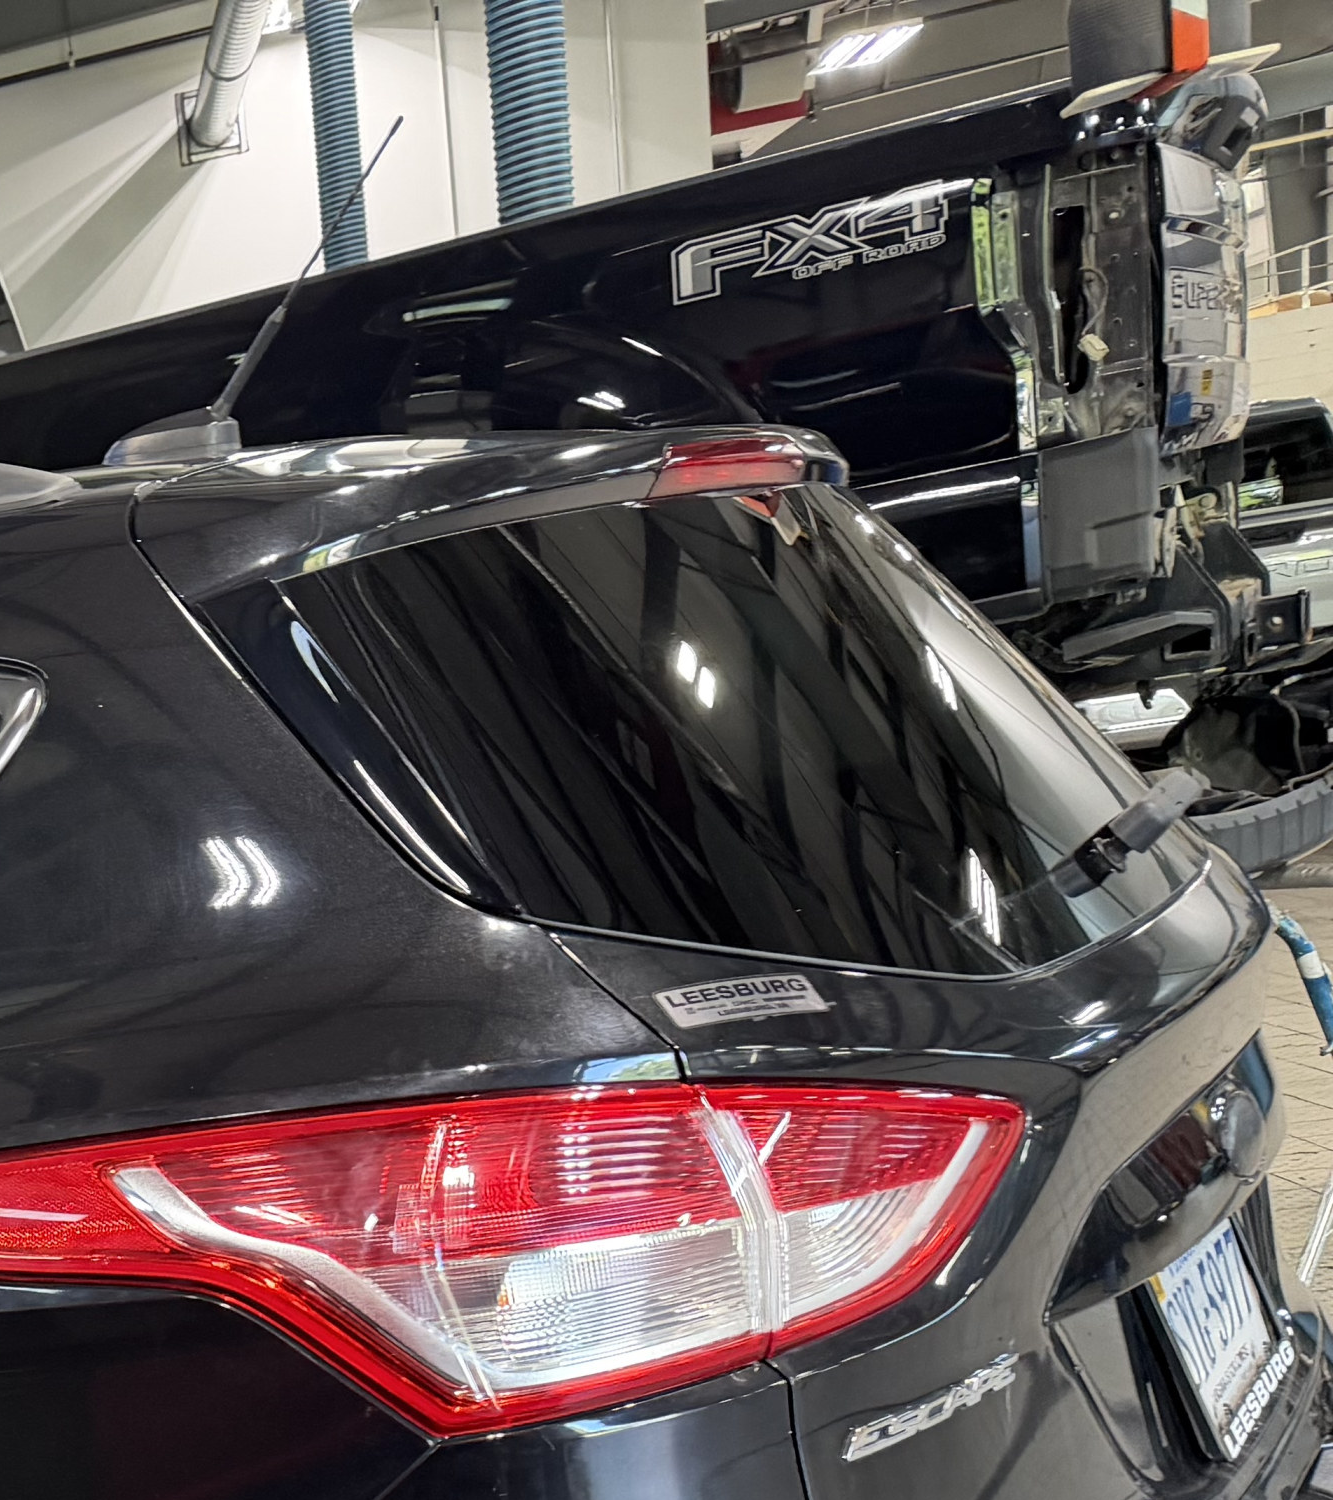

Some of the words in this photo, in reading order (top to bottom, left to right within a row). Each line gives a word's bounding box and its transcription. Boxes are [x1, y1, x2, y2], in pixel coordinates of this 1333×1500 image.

[671, 179, 948, 305] FX4
[792, 254, 853, 280] OFF
[863, 233, 947, 264] ROAD
[664, 978, 809, 1009] LEESBURG
[1222, 1339, 1296, 1460] LEESBURG
